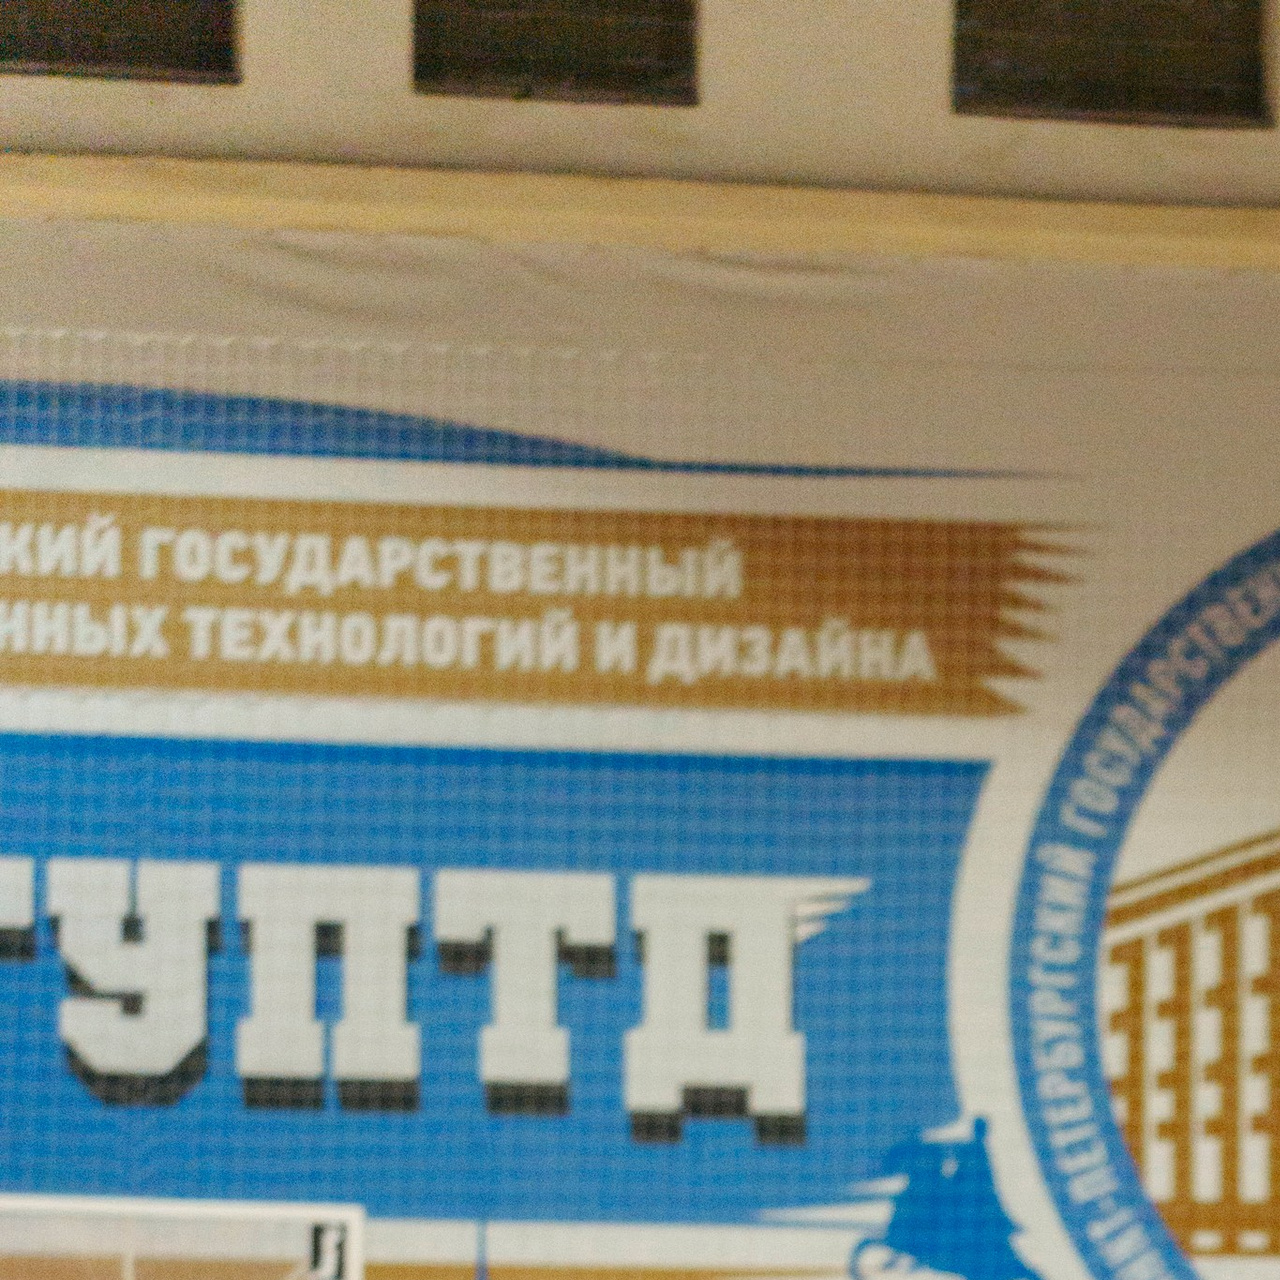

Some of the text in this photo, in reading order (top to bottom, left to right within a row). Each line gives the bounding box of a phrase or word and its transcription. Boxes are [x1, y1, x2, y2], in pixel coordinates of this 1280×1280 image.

[140, 526, 743, 598] ГОСУДАРСТВЕННЫЙ
[182, 605, 580, 674] ТЕХНОЛОГИЙ
[595, 620, 637, 672] И
[645, 616, 938, 685] ДИЗАЙНА
[0, 853, 870, 1143] УПТД
